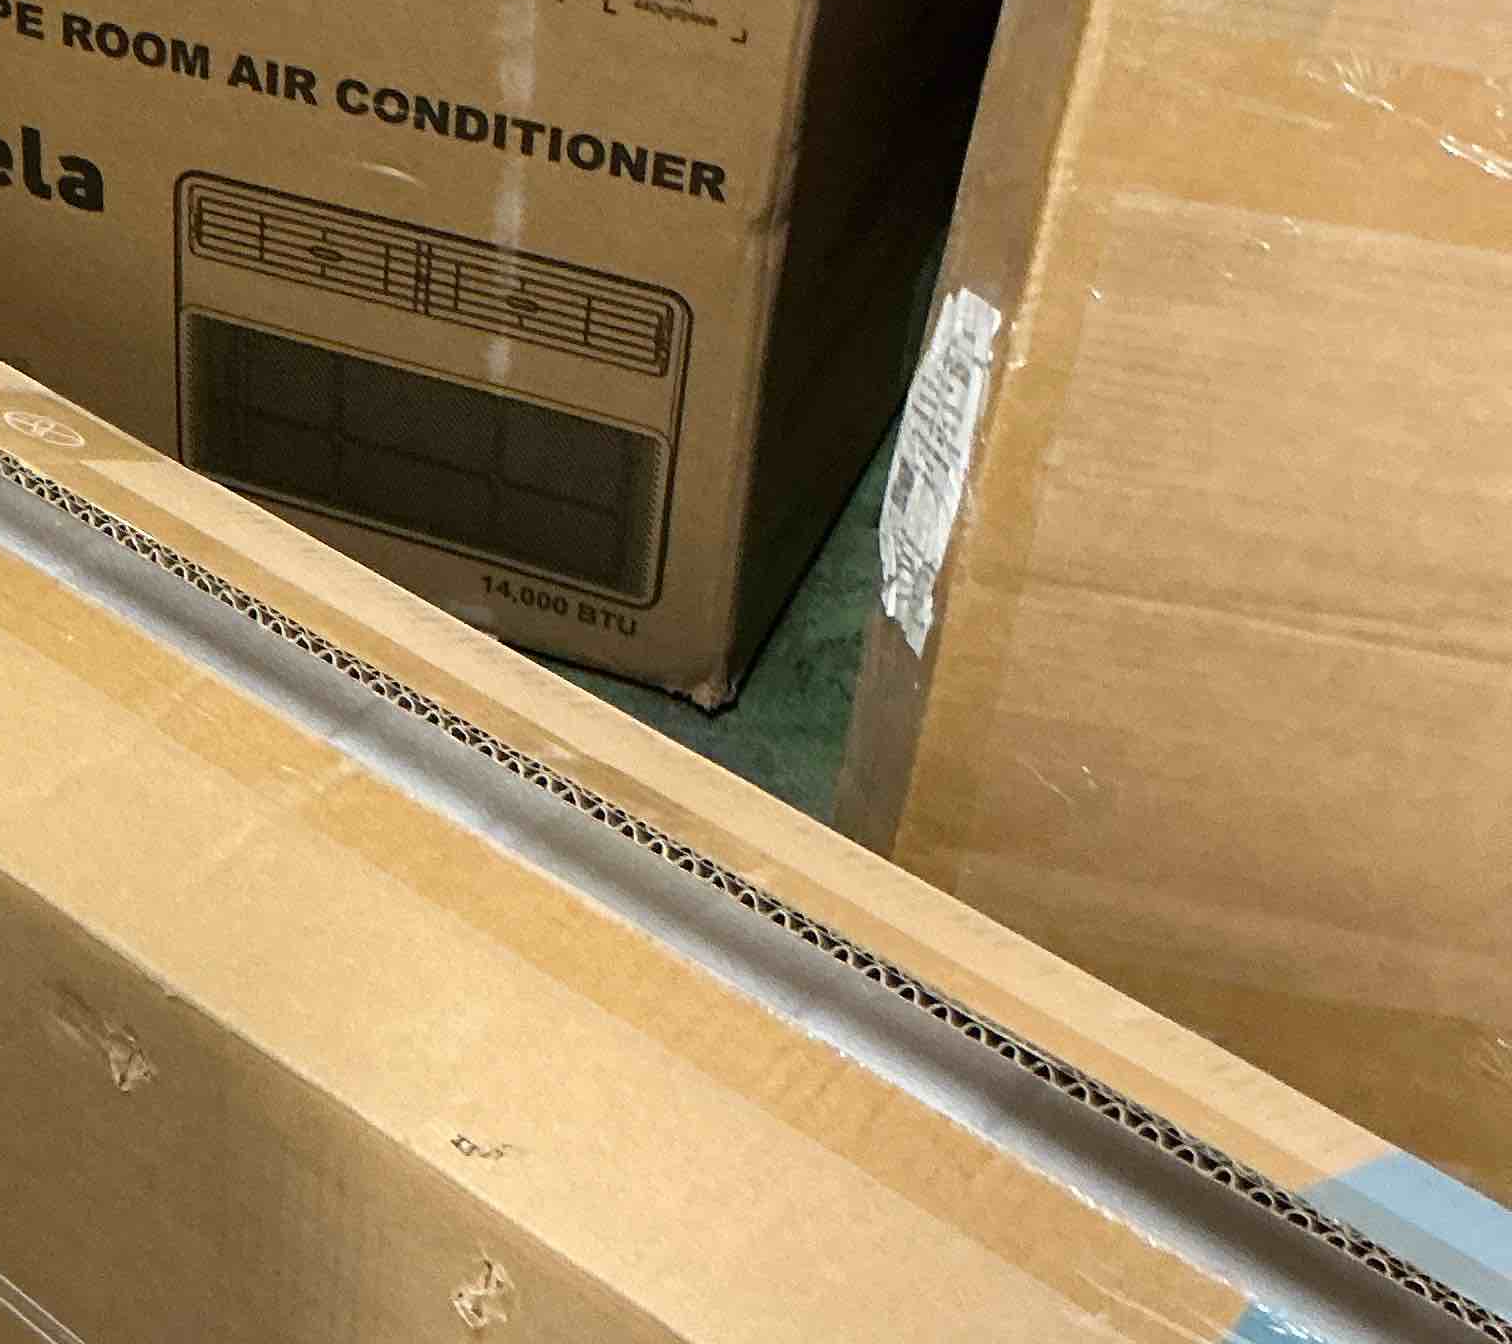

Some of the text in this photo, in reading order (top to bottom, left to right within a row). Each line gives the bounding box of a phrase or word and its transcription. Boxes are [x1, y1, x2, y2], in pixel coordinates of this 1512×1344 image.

[61, 12, 211, 81] ROOM
[227, 52, 318, 106] AIR
[335, 78, 727, 203] CONDITIONER
[480, 574, 638, 638] 14,000 BTU
